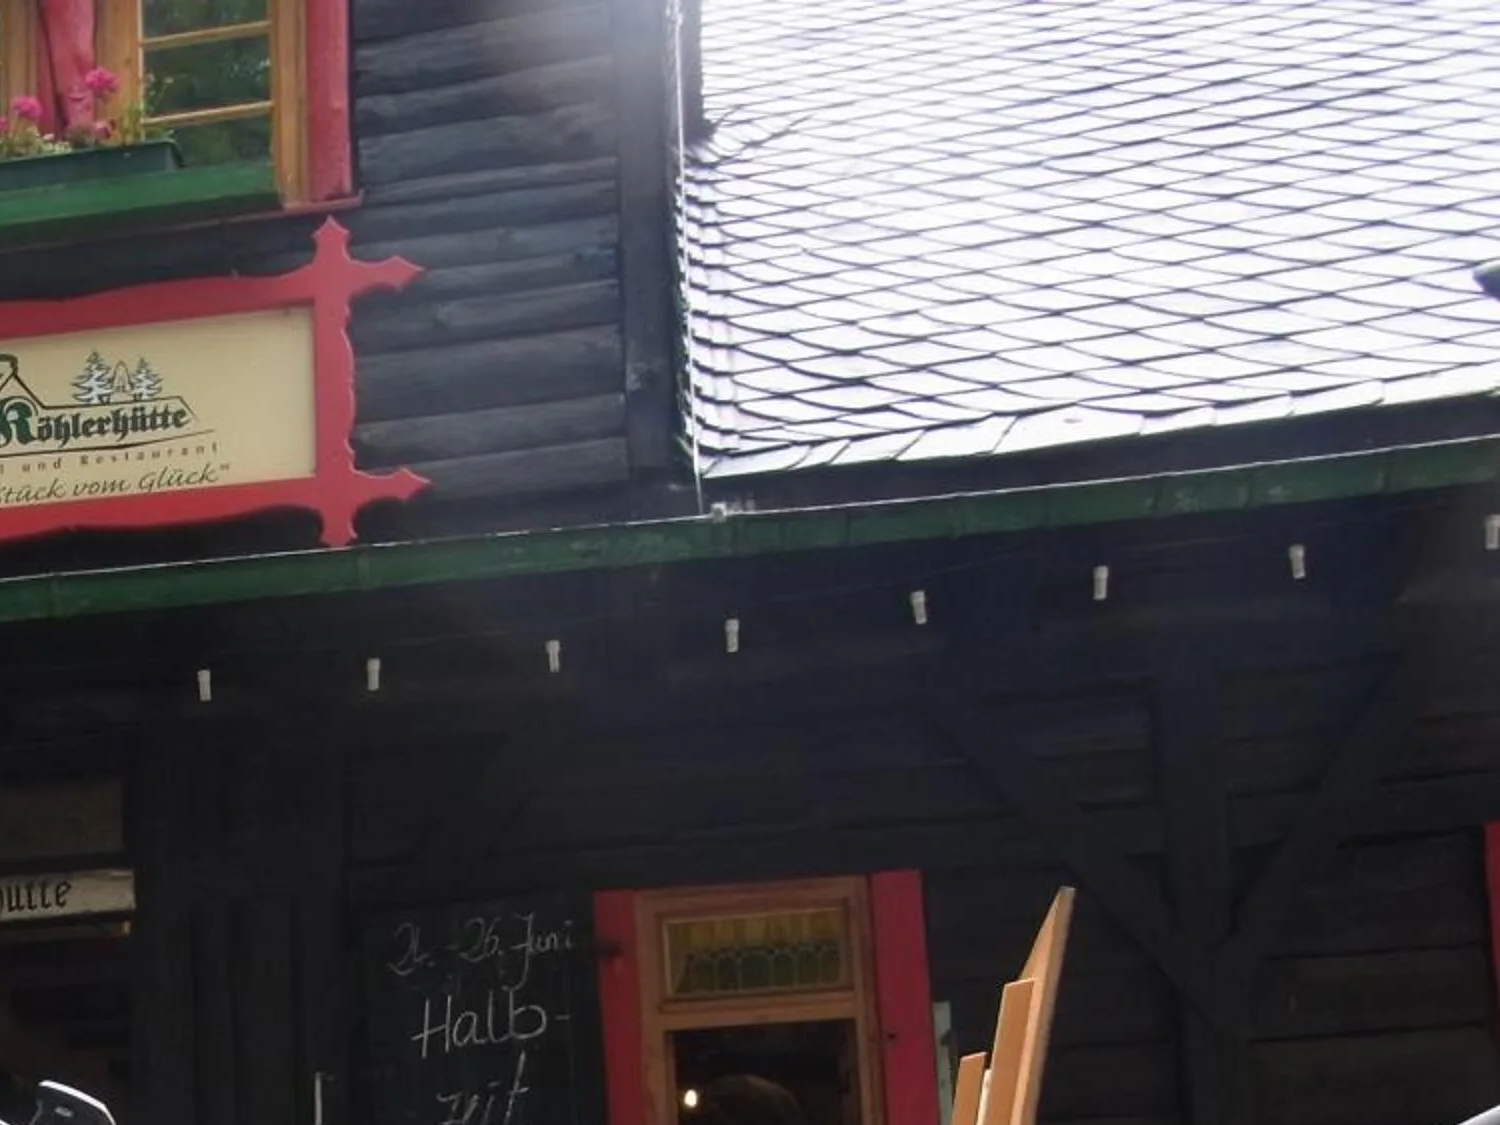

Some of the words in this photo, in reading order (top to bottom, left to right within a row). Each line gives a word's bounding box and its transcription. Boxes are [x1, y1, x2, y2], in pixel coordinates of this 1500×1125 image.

[22, 458, 63, 473] und
[80, 442, 219, 466] Restaurant
[73, 479, 132, 498] vom
